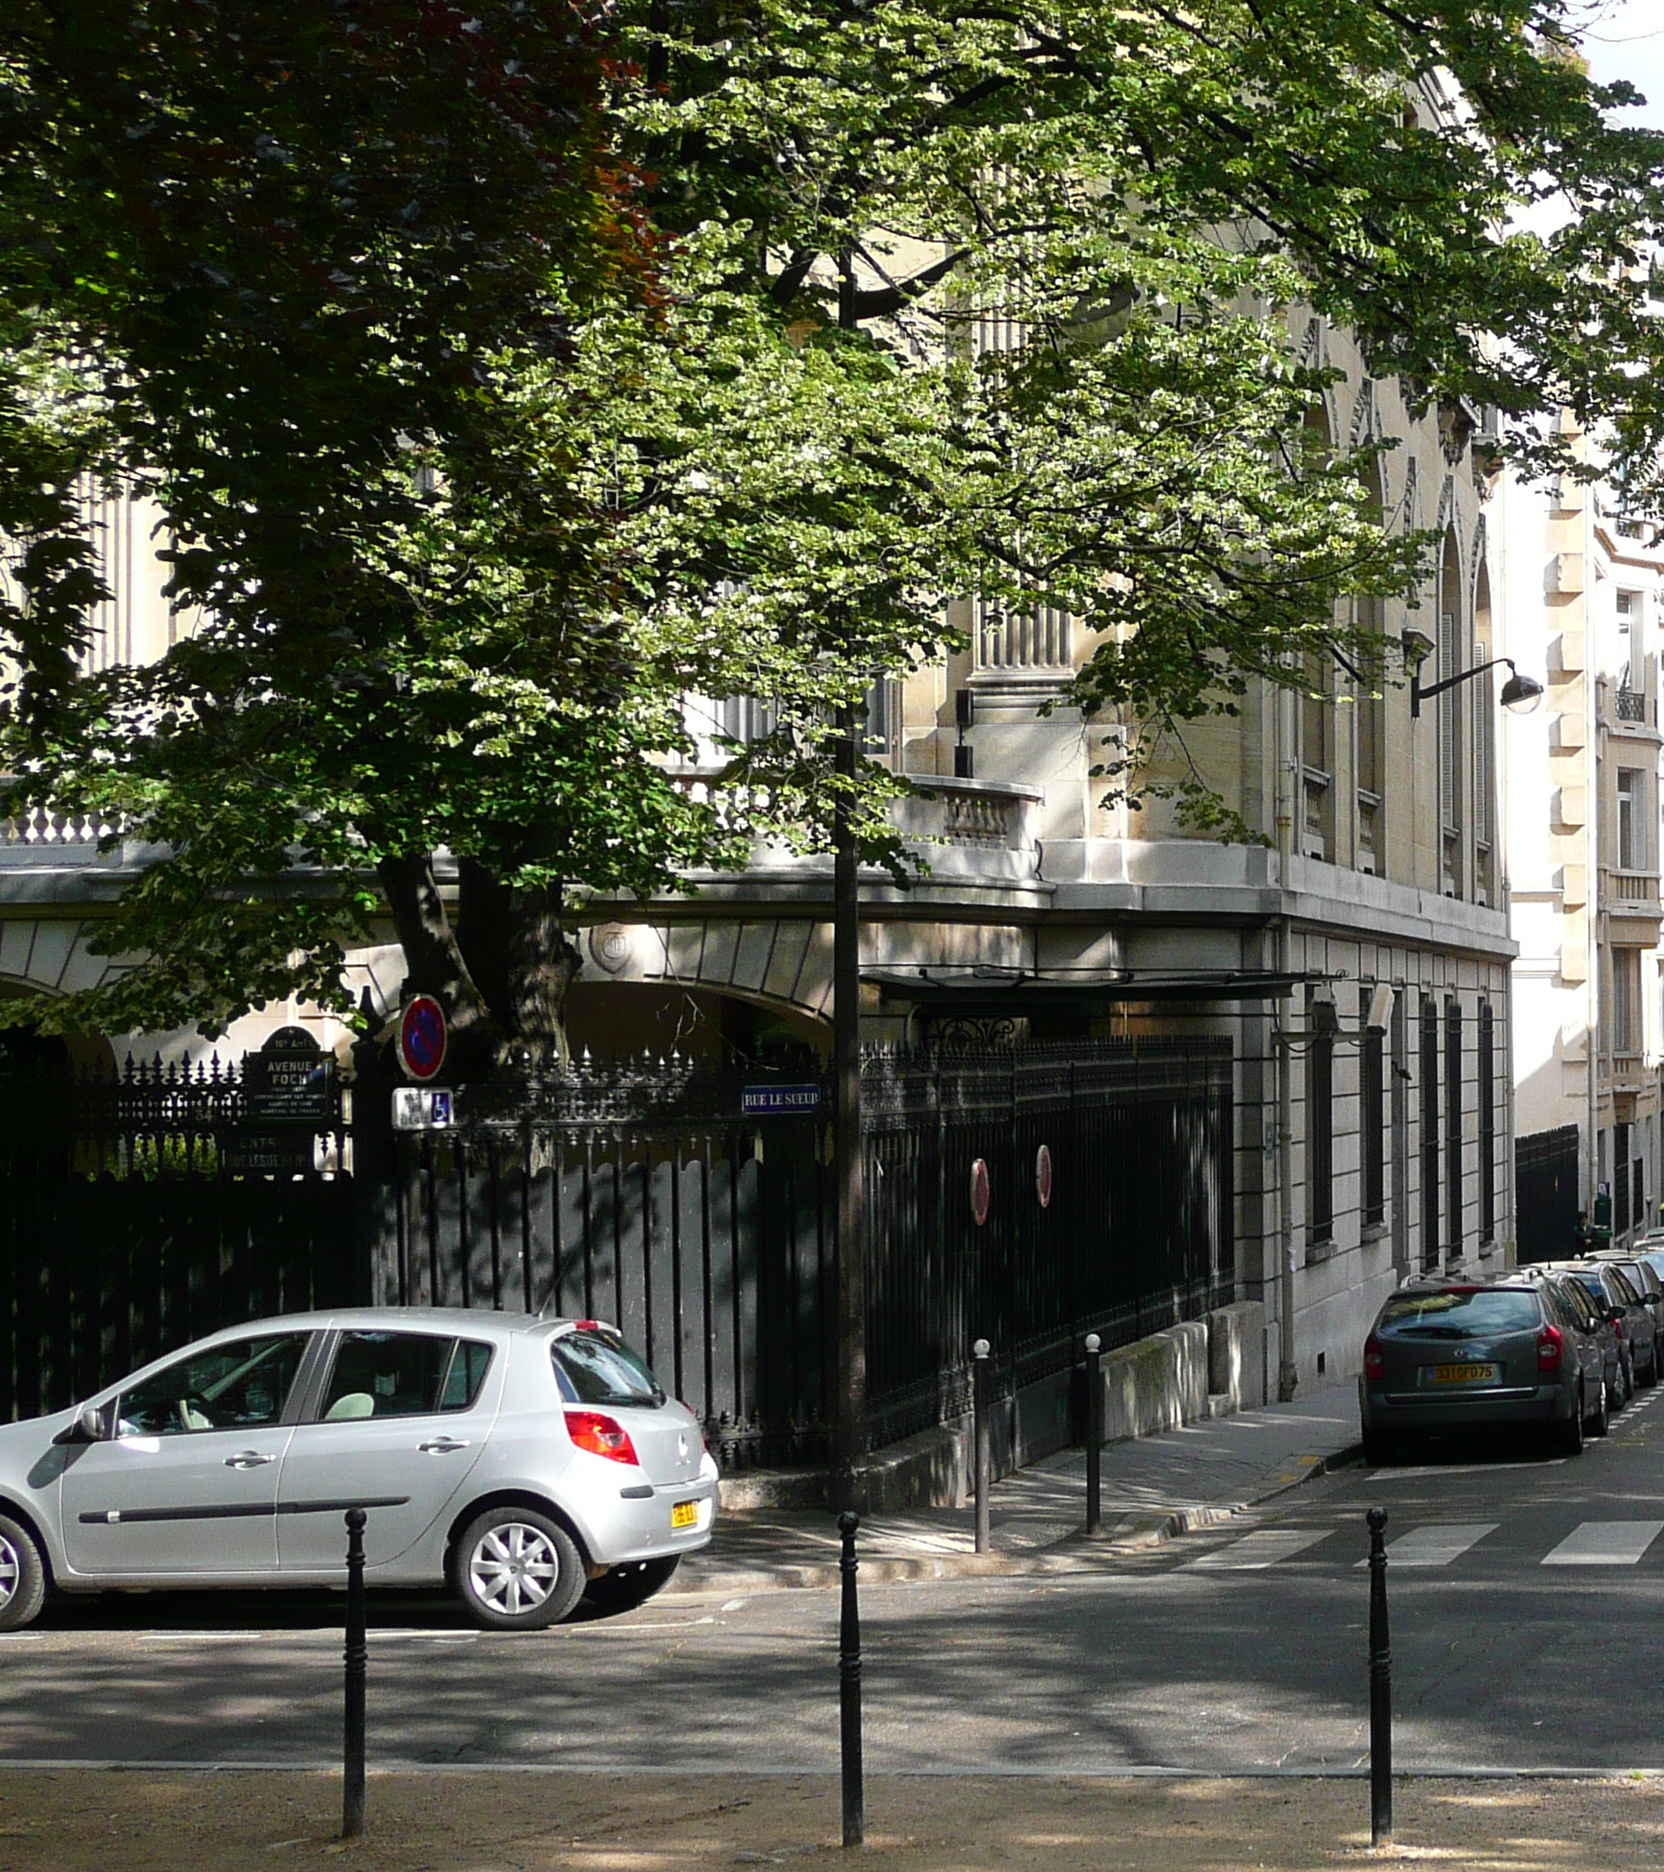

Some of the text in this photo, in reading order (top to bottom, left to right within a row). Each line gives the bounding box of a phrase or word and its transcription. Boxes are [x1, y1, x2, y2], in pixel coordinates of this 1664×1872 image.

[267, 1061, 312, 1072] AVENUE
[272, 1074, 308, 1085] FOCH
[745, 1093, 818, 1106] RUE LE SUEUR
